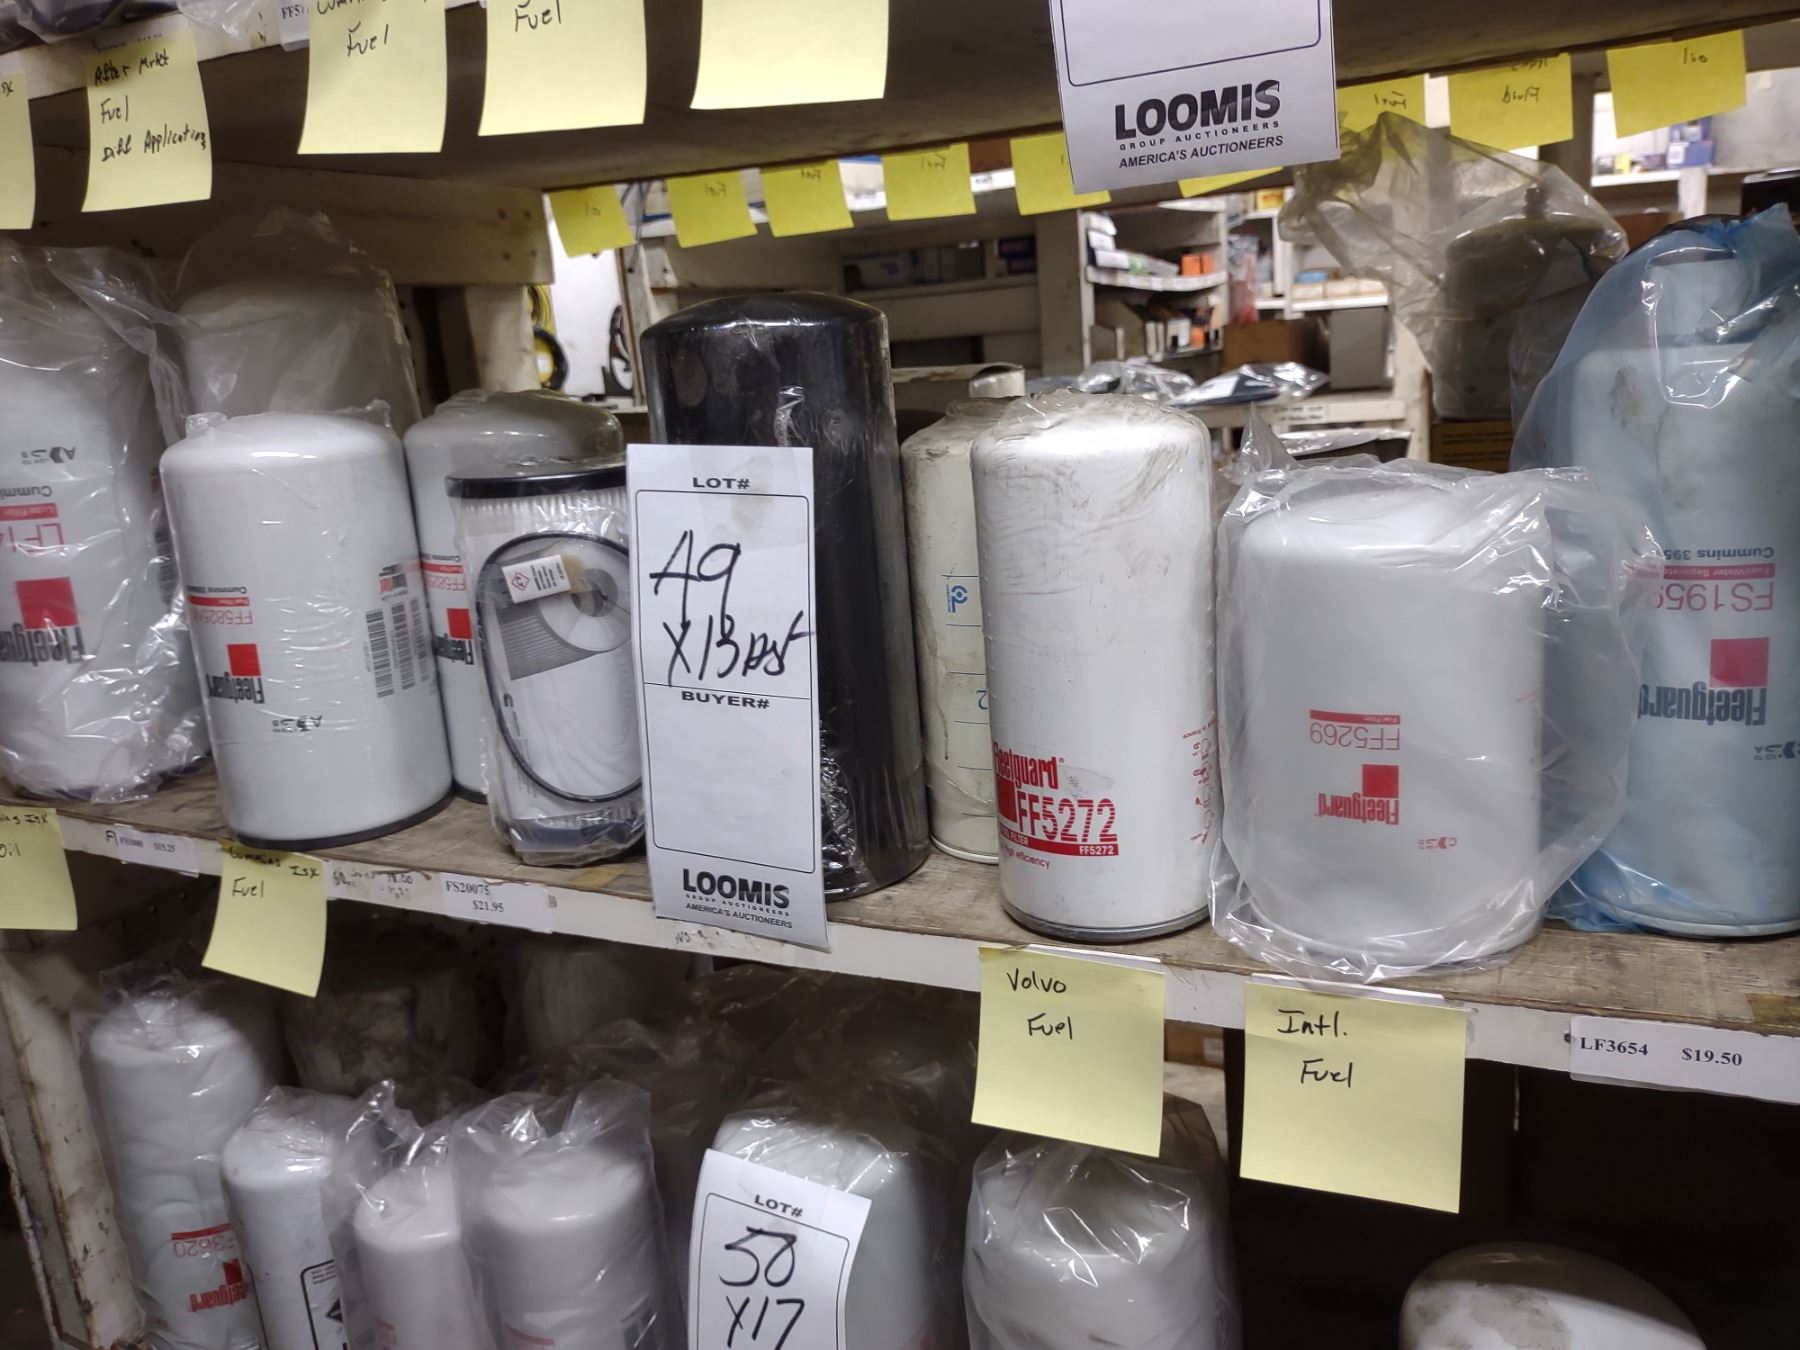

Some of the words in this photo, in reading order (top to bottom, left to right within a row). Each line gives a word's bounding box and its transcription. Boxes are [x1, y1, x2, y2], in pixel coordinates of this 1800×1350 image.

[347, 21, 389, 57] Fuel
[100, 94, 129, 124] Fuel
[1115, 79, 1281, 140] LOOMIS
[1119, 138, 1166, 151] GROUP
[1175, 120, 1280, 143] AUCTIONEERS
[1118, 149, 1188, 169] AMERICA'S
[1190, 135, 1284, 159] AUCTIONEERS
[0, 485, 53, 498] Cummi
[693, 477, 750, 489] LOT#
[1664, 549, 1691, 561] 395
[1697, 546, 1774, 559] Cummins
[649, 529, 741, 642] 49
[681, 690, 770, 709] BUYER#
[1637, 681, 1767, 726] Fleetguard
[1310, 722, 1400, 751] FF5269
[1016, 789, 1118, 843] FF5272
[1318, 792, 1399, 826] Fleetguard
[1079, 845, 1115, 855] FF5272
[232, 876, 264, 898] Fuel
[683, 868, 790, 909] LOOMIS
[685, 903, 731, 917] AMERICA'S
[732, 911, 793, 929] AUCTIONEERS
[1007, 968, 1067, 994] Volvo
[1027, 1012, 1073, 1040] Fuel
[1276, 1008, 1348, 1037] Intl.
[1579, 1037, 1649, 1056] LF3654
[1681, 1047, 1743, 1067] $19.50
[1300, 1058, 1353, 1088] Fuel
[754, 1194, 804, 1218] LOT#
